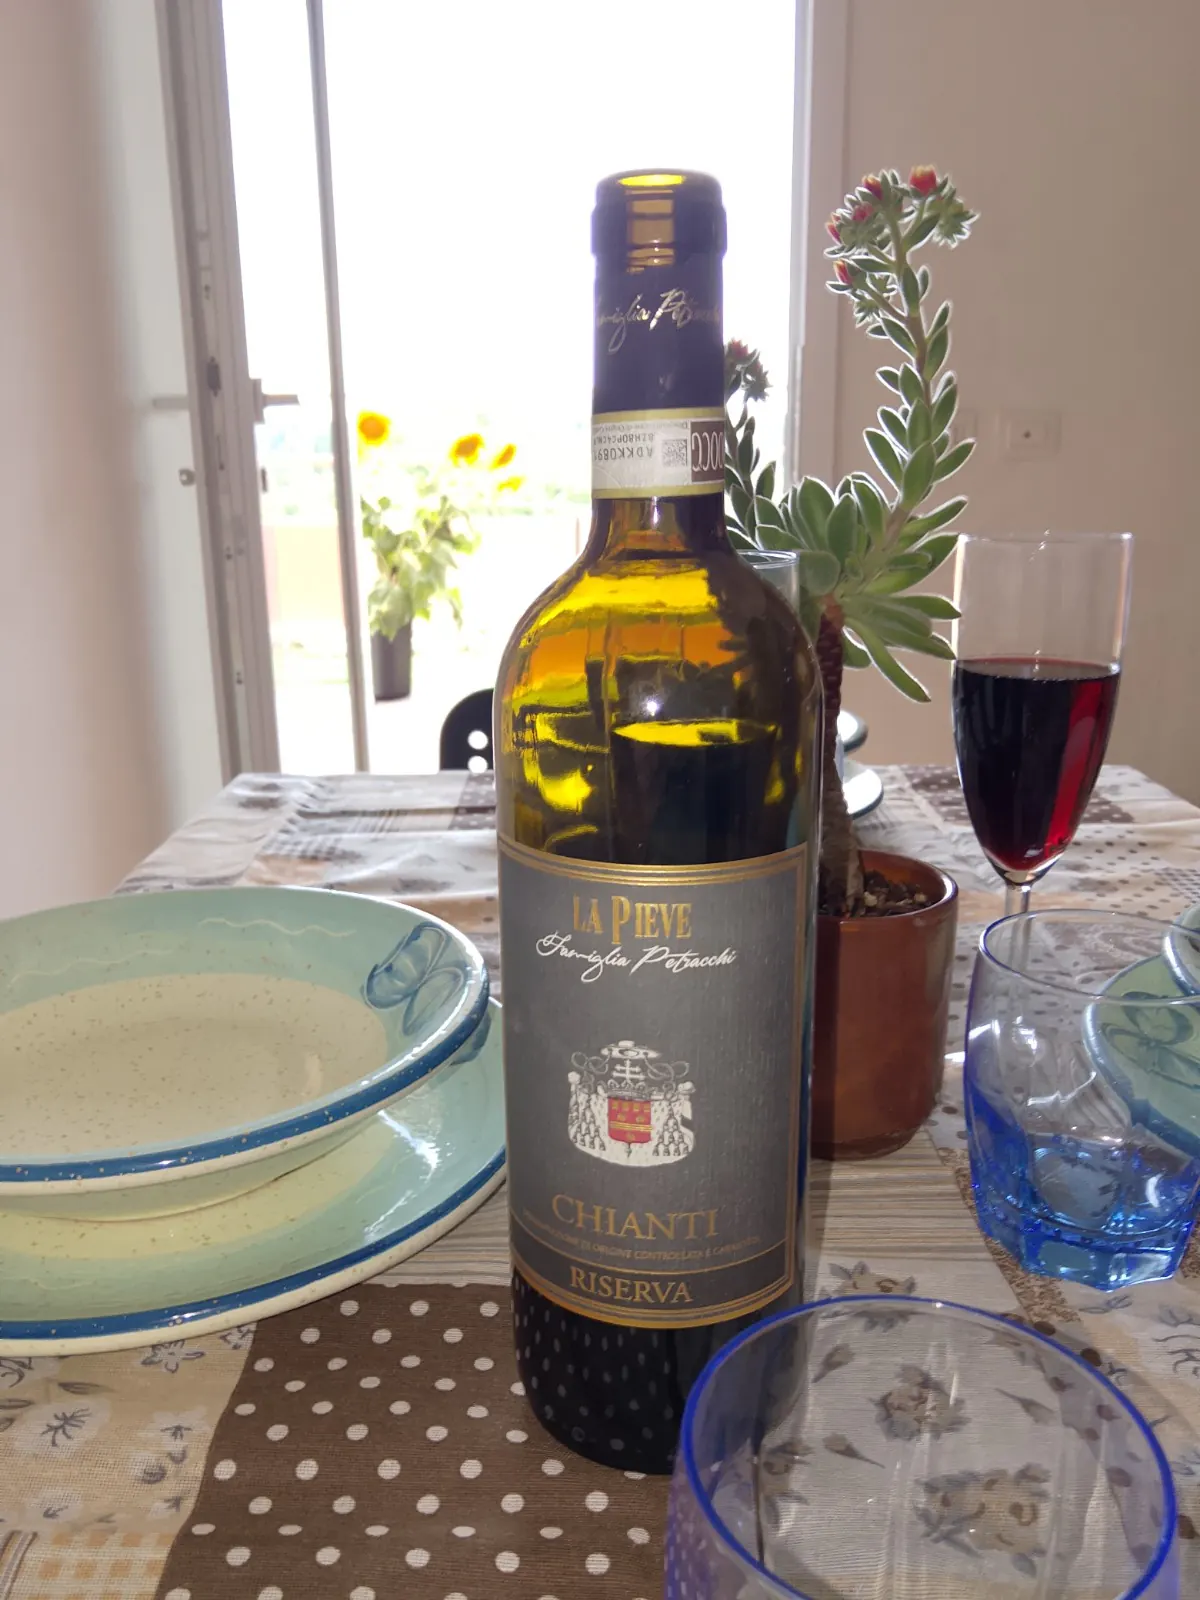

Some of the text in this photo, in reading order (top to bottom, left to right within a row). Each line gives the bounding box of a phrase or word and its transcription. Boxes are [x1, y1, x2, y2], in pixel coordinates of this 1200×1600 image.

[572, 893, 692, 945] LA PIEVE
[535, 930, 737, 983] Famiglia Petracchi
[552, 1194, 719, 1240] CHIANTI
[570, 1266, 694, 1304] RISERVA
